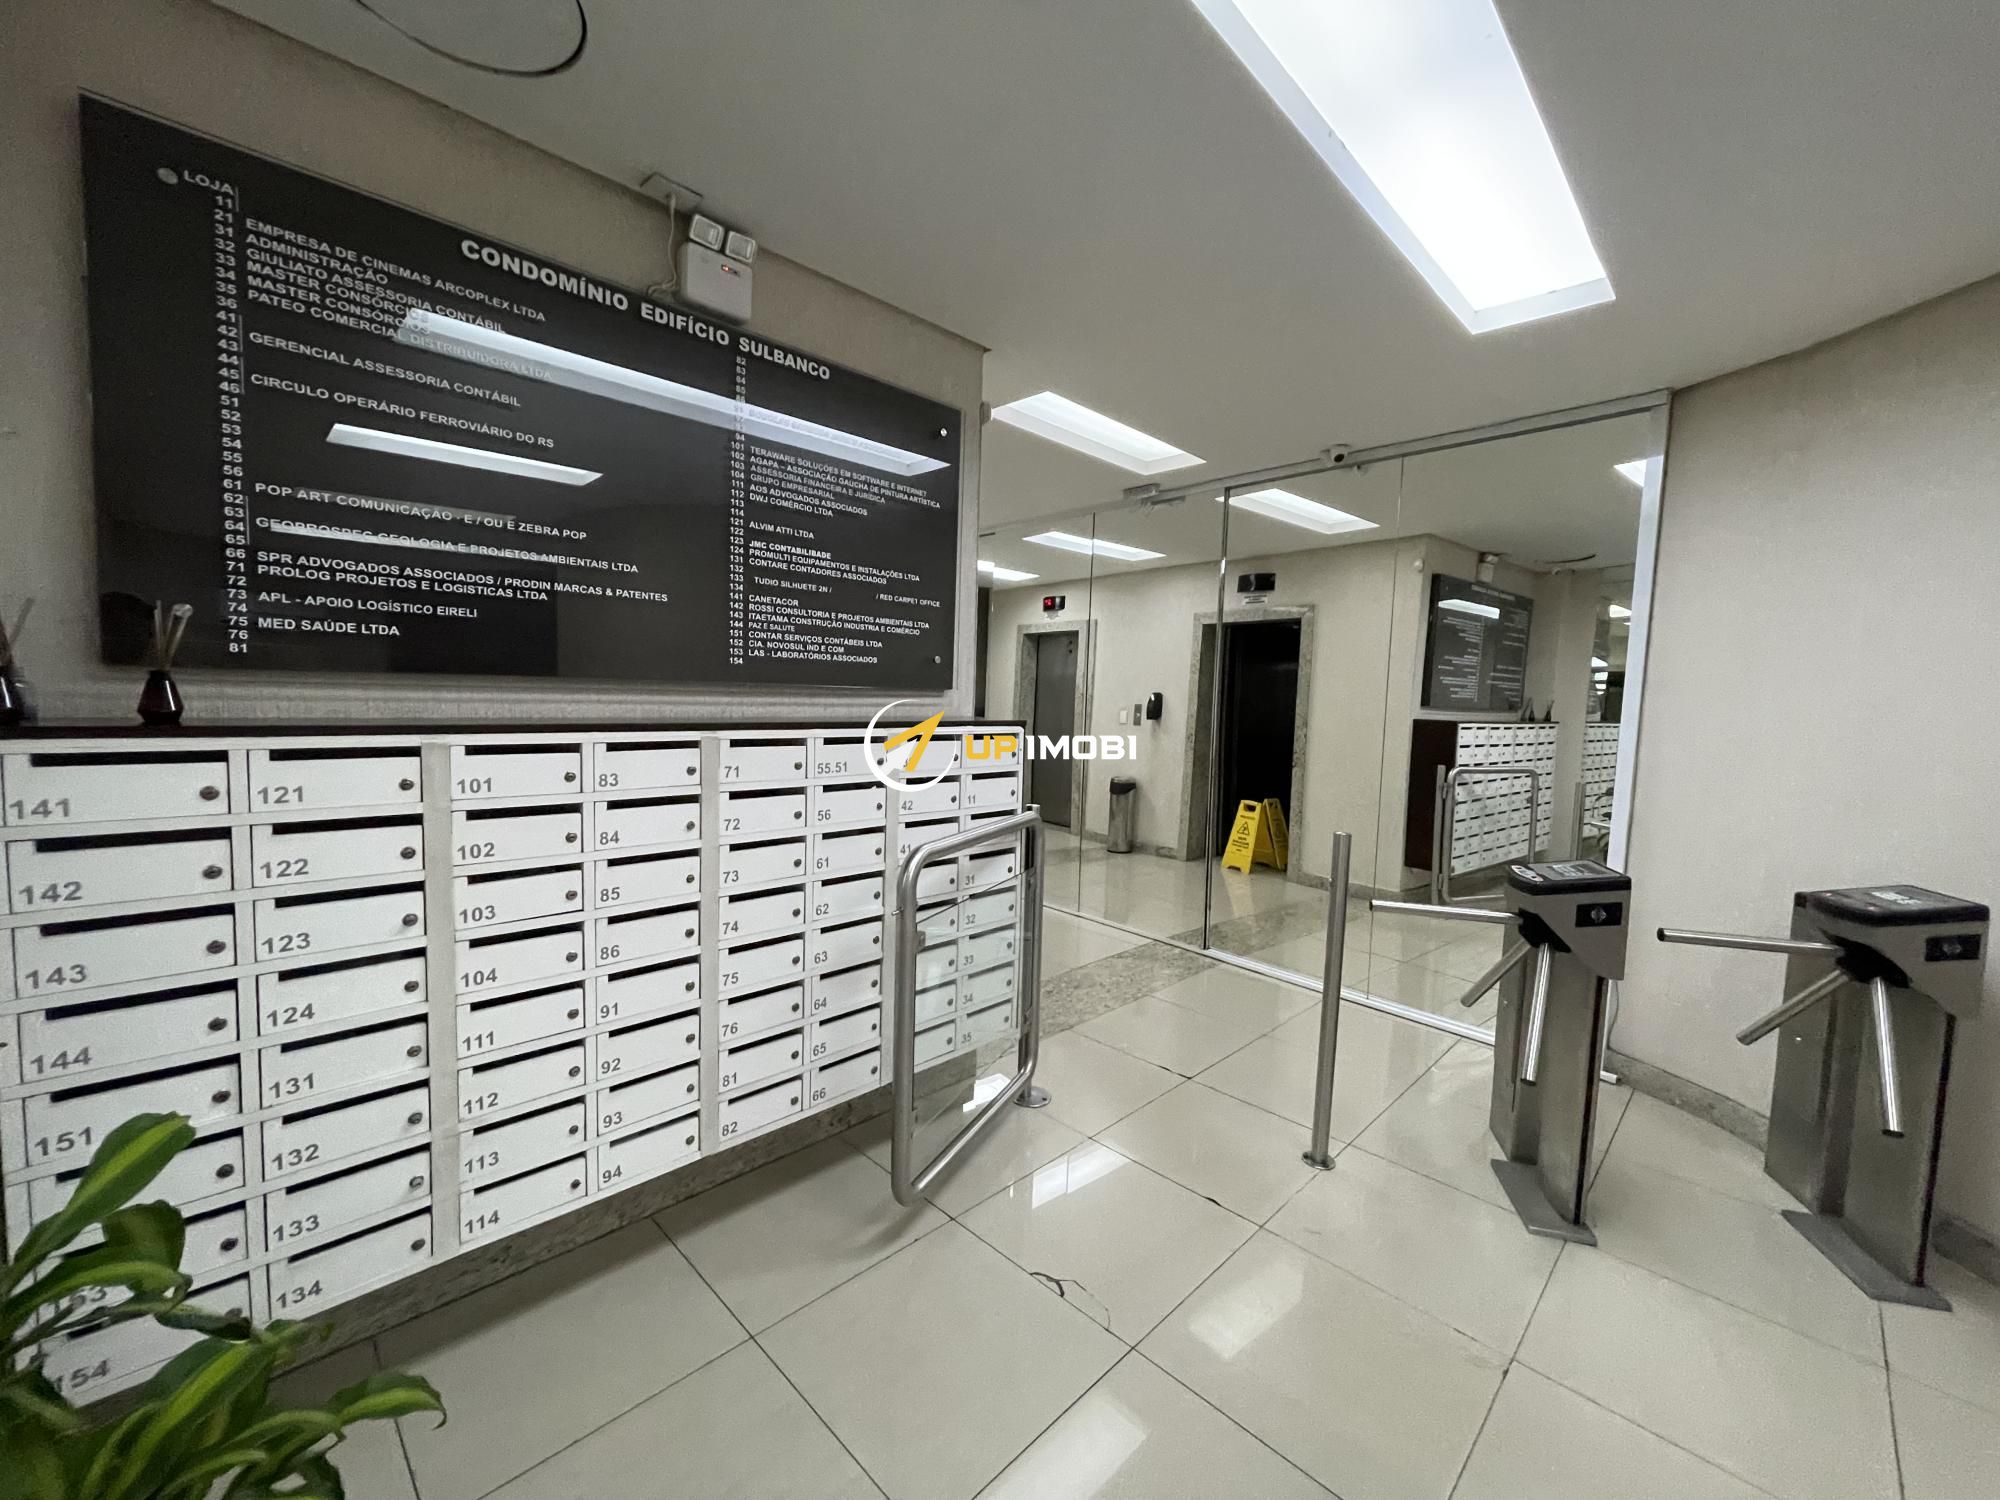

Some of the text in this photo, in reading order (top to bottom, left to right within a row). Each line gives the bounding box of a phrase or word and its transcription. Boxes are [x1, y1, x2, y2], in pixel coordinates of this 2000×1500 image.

[184, 170, 234, 195] LOJA
[246, 233, 388, 284] ADMINISTRAÇÃO
[246, 218, 546, 322] EMPRESA DE CINEMAS ARCOPLEX LTDA
[247, 261, 320, 291] MASTER
[246, 248, 506, 334] GIULIATO ASSESSORIA CONTÁBIL
[247, 275, 321, 304] MASTER
[248, 289, 305, 313] PATEO
[310, 306, 404, 341] COMERCIAL
[461, 238, 831, 381] CONDOMÍNIO EDIFÍCIO SULBANCO
[249, 332, 521, 407] GERENCIAL ASSESSORIA CONTÁBIL
[219, 395, 239, 407] 51
[221, 409, 241, 422] 52
[251, 373, 555, 448] CIRCULO OPERÁRIO FERROVIÁRIO DO RS
[221, 423, 242, 435] 53
[222, 437, 242, 449] 54
[222, 451, 243, 464] 55
[223, 464, 244, 477] 56
[223, 478, 242, 490] 61
[223, 492, 244, 504] 62
[224, 506, 244, 518] 63
[255, 482, 293, 497] POP
[296, 489, 330, 503] ART
[484, 517, 503, 528] OU
[518, 522, 560, 537] ZEBRA
[563, 529, 587, 540] POP
[770, 497, 833, 517] COMÉRCIO LTDA
[224, 520, 245, 532] 64
[749, 521, 815, 539] ALVIM ATTI LTDA
[224, 534, 246, 546] 65
[225, 548, 246, 560] 66
[470, 543, 538, 560] PROJETOS
[541, 553, 609, 570] AMBIENTAIS
[611, 563, 639, 573] LTDA
[227, 561, 245, 573] 71
[749, 557, 887, 584] CONTARE CONTADORES ASSOCIADOS
[227, 575, 247, 586] 72
[257, 551, 668, 602] SPR ADVOGADOS ASSOCIADOS PRODIN MARCAS PATENTES
[257, 564, 548, 601] PROLOG PROJETOS E LOGISTICAS LTDA
[227, 589, 248, 600] 73
[749, 594, 799, 606] CANETACOR
[228, 602, 248, 613] 74
[258, 592, 478, 618] APL APOIO LOGÍSTICO EIRELI
[749, 603, 830, 619] ROSSI CONSULTORIA
[228, 616, 249, 627] 75
[258, 617, 400, 636] MED SAÚDE LTDA
[228, 629, 249, 640] 76
[749, 631, 883, 648] CONTAR SERVIÇOS CONTÁBEIS LTDA
[229, 643, 248, 653] 81
[772, 650, 831, 661] LABORATÓRIOS
[833, 654, 877, 664] ASSOCIADOS
[724, 766, 740, 779] 71
[817, 761, 848, 775] 55.51
[457, 777, 493, 795] 101
[598, 773, 619, 788] 83
[257, 786, 305, 805] 121
[967, 795, 976, 804] 11
[9, 799, 71, 820] 141
[901, 800, 913, 811] 42
[817, 809, 832, 823] 56
[724, 818, 741, 832] 72
[599, 831, 620, 846] 84
[457, 842, 496, 861] 102
[260, 858, 310, 879] 122
[816, 856, 830, 871] 61
[723, 870, 740, 884] 73
[965, 875, 975, 886] 31
[19, 881, 84, 906] 142
[600, 887, 620, 902] 85
[459, 905, 497, 924] 103
[815, 903, 830, 917] 62
[965, 913, 976, 926] 32
[722, 921, 740, 936] 74
[262, 933, 312, 955] 123
[600, 944, 620, 960] 86
[814, 951, 828, 964] 63
[24, 964, 88, 990] 143
[460, 967, 498, 989] 104
[722, 972, 739, 987] 75
[600, 1002, 619, 1018] 91
[814, 997, 827, 1010] 64
[267, 1003, 316, 1028] 124
[722, 1022, 739, 1038] 76
[462, 1031, 495, 1052] 111
[813, 1042, 827, 1056] 65
[31, 1047, 93, 1075] 144
[601, 1057, 621, 1075] 92
[269, 1073, 316, 1100] 131
[722, 1072, 737, 1088] 81
[813, 1087, 826, 1102] 66
[464, 1092, 499, 1115] 112
[603, 1111, 623, 1129] 93
[722, 1121, 738, 1137] 82
[35, 1126, 94, 1157] 151
[272, 1143, 320, 1171] 132
[464, 1151, 500, 1174] 113
[602, 1165, 623, 1184] 94
[273, 1214, 321, 1243] 133
[464, 1210, 500, 1234] 114
[276, 1279, 324, 1310] 134
